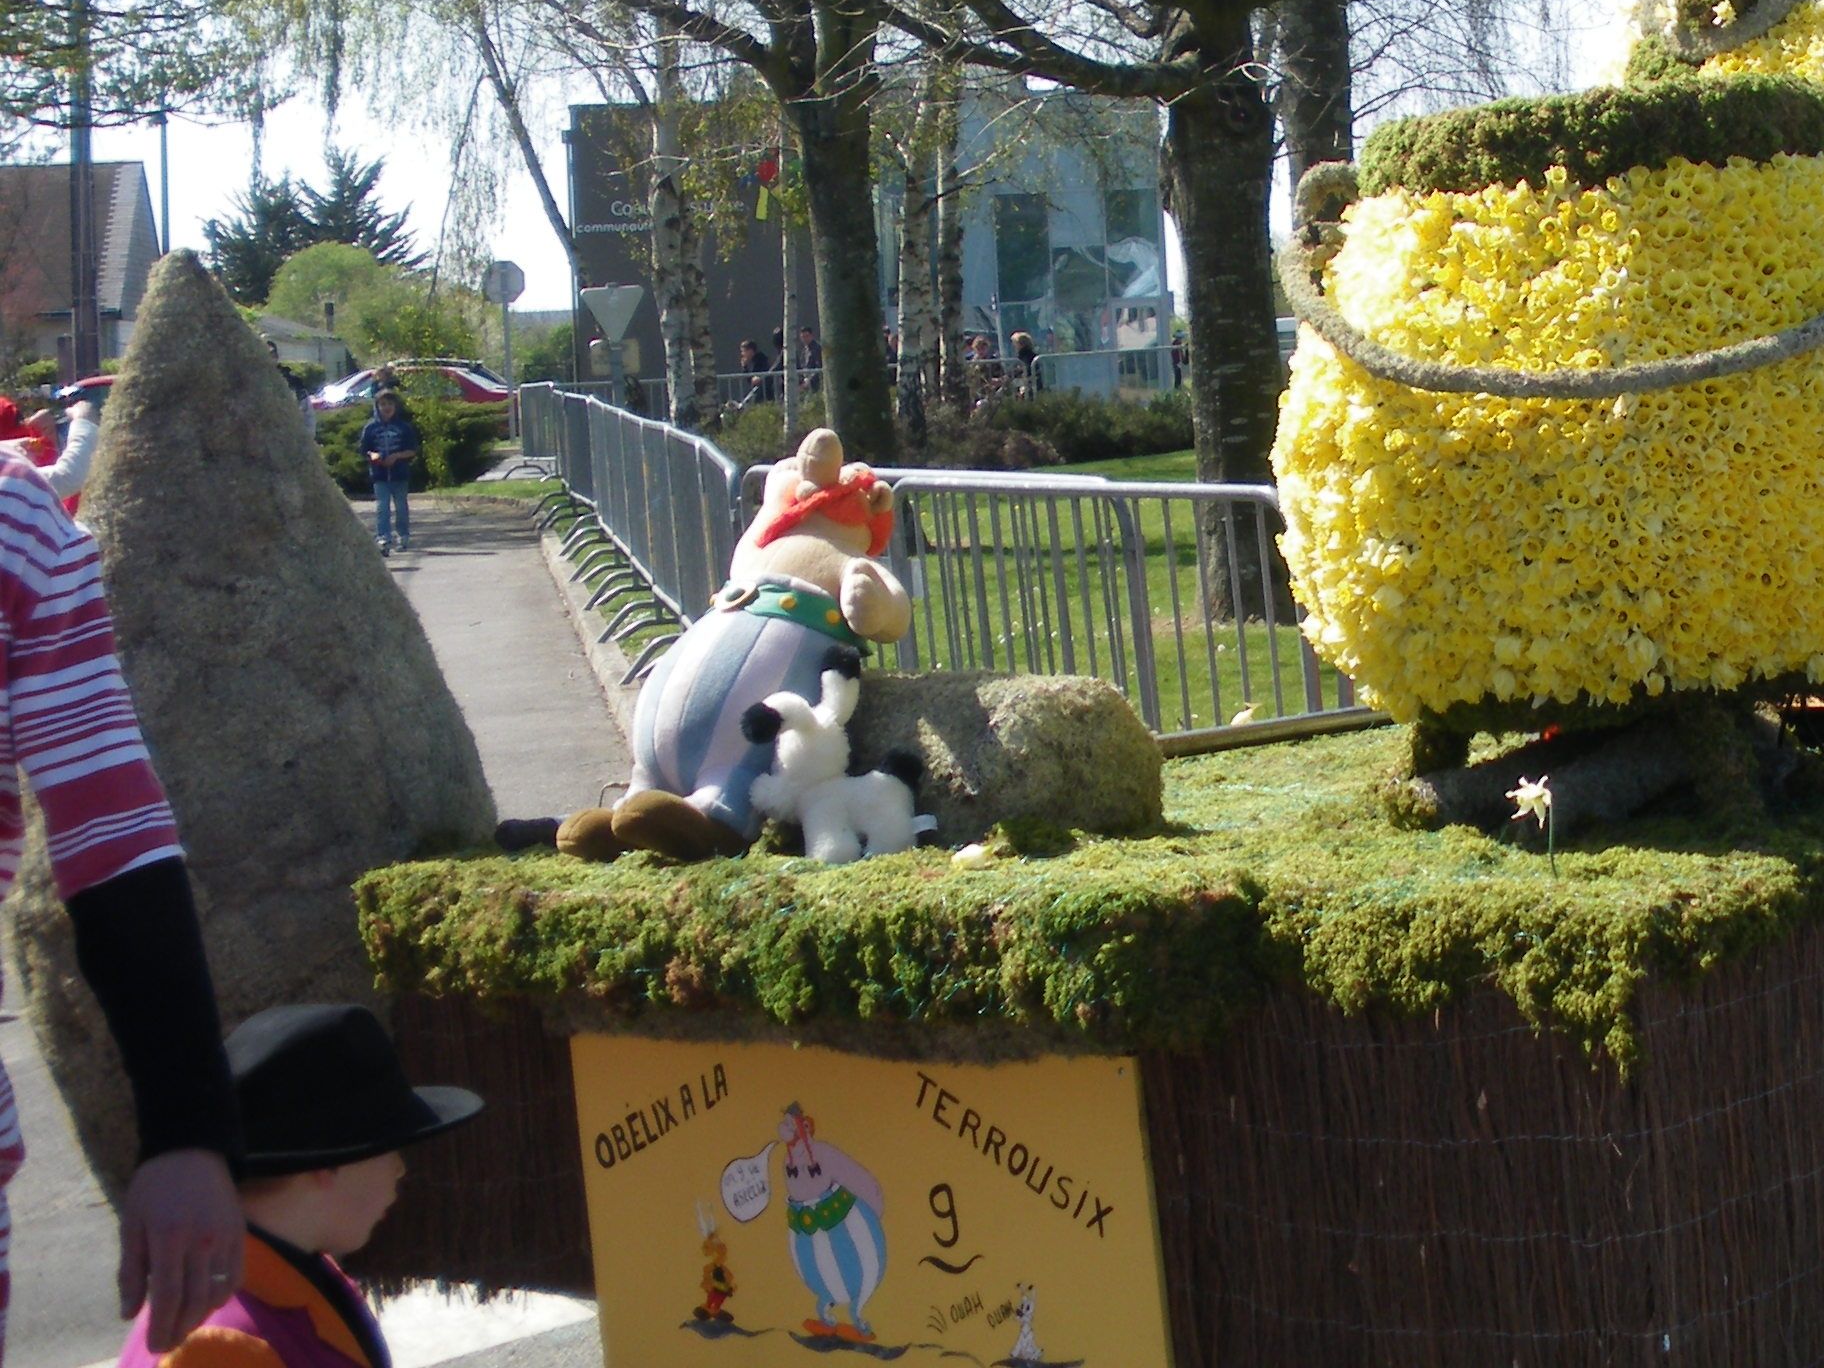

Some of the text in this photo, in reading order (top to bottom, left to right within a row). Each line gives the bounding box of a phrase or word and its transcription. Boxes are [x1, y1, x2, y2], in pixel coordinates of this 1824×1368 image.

[680, 1083, 696, 1121] A
[701, 1062, 728, 1110] LA
[950, 1292, 984, 1324] OUAH
